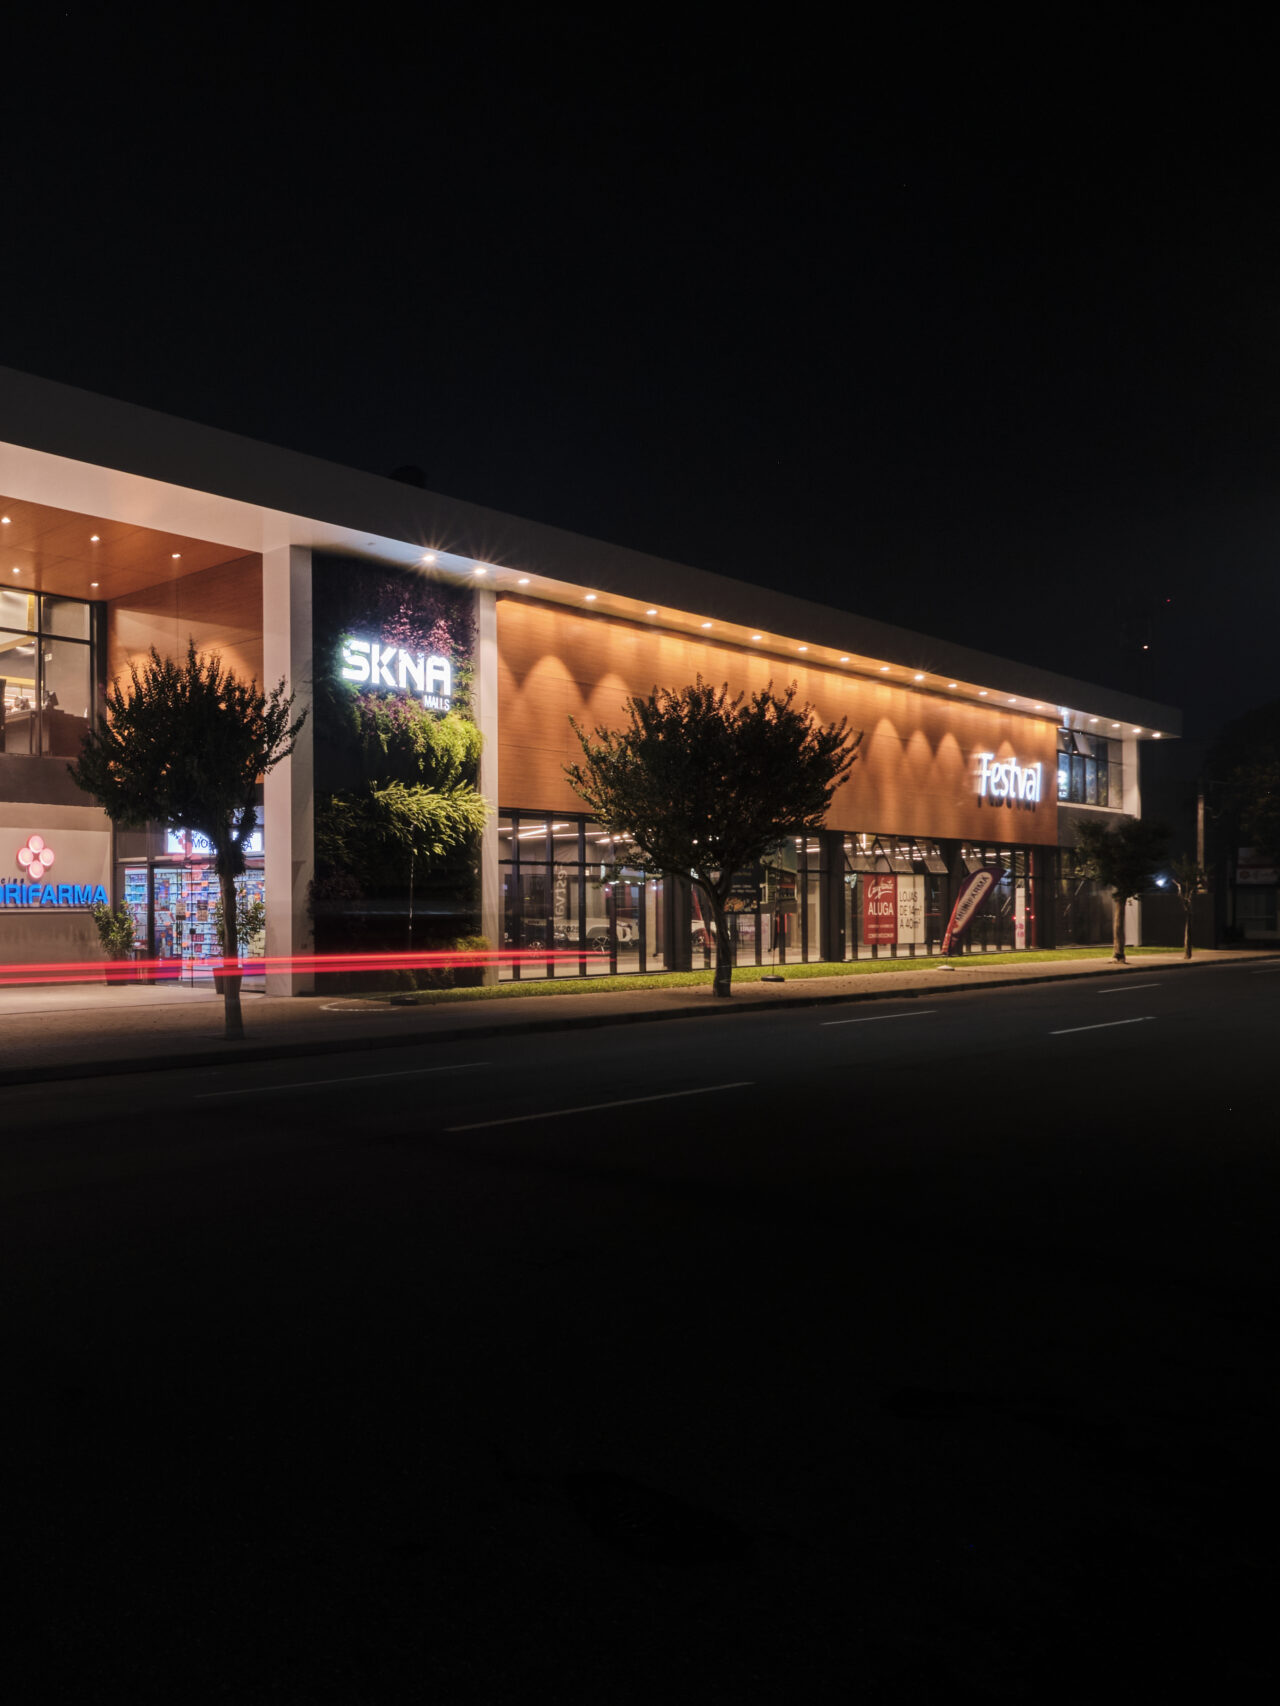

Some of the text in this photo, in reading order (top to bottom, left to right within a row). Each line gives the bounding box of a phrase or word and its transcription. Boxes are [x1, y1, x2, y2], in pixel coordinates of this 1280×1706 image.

[342, 639, 451, 695] SKNA
[976, 752, 1042, 802] Festval
[867, 902, 895, 916] ALUGA
